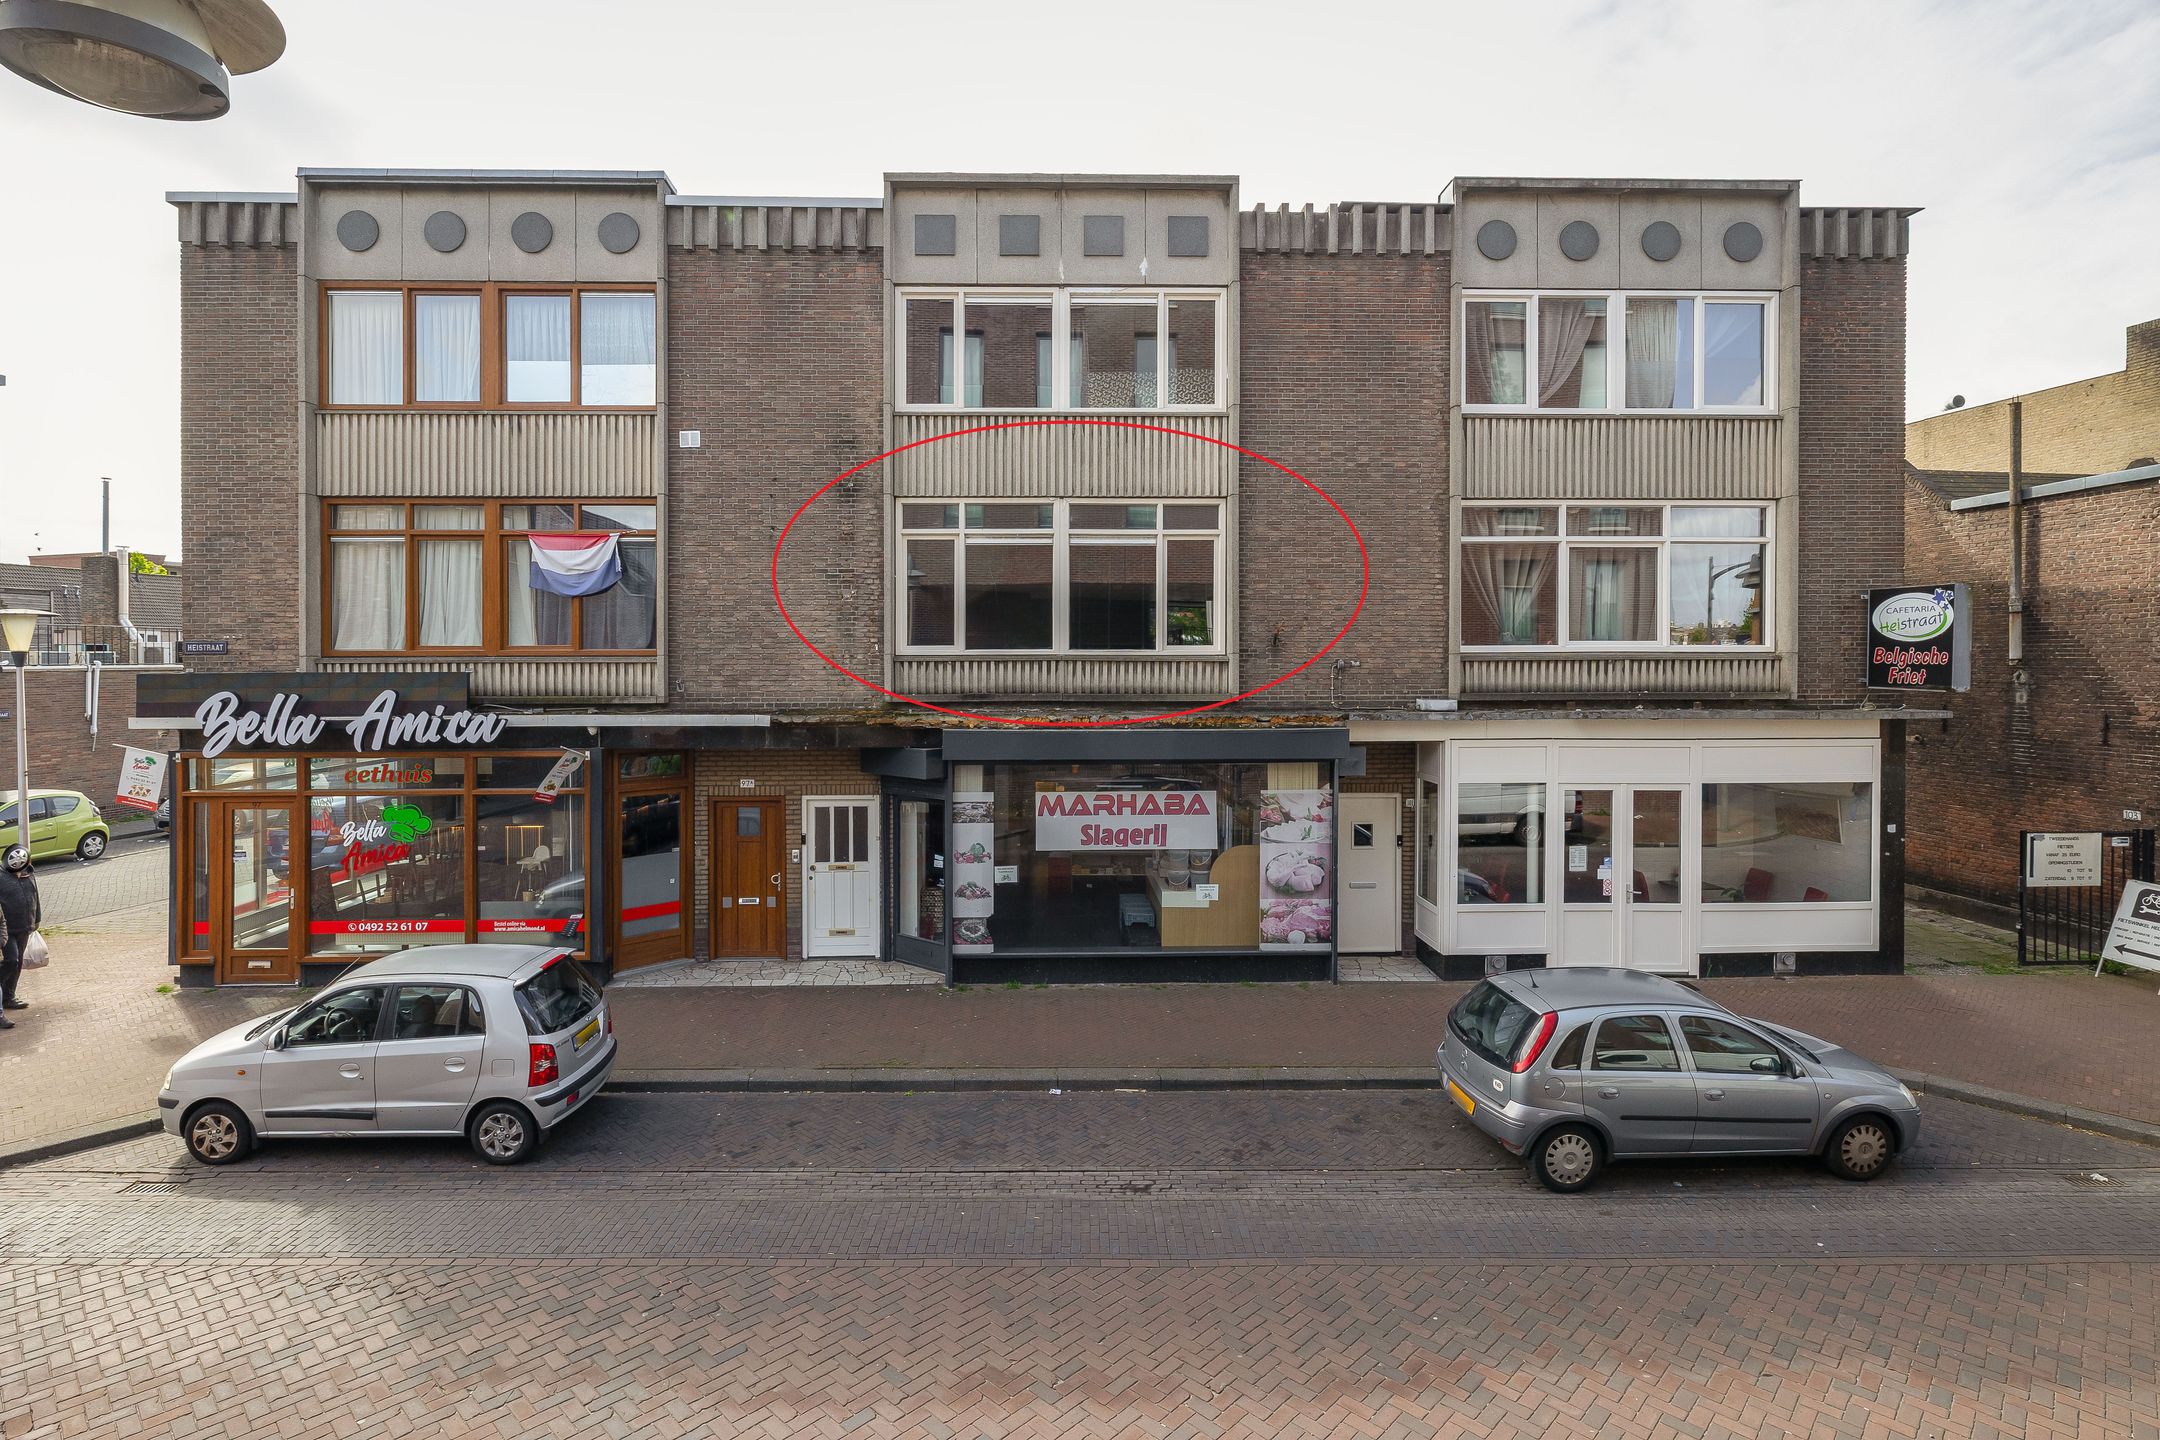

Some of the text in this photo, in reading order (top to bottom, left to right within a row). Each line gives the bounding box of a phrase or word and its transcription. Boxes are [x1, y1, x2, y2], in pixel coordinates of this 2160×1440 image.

[1886, 605, 1936, 615] CAFETARIA
[1880, 612, 1943, 633] Heistraat
[1873, 646, 1949, 668] Belgische
[1888, 666, 1927, 684] Friet
[194, 689, 507, 758] Bella Amica
[344, 763, 433, 783] eethuis
[1037, 793, 1211, 816] MARHABA
[2125, 811, 2139, 819] 103
[340, 820, 387, 847] Bella
[1080, 823, 1168, 848] Slagerij
[341, 841, 411, 873] Amica
[358, 922, 428, 932] 0492 52 61 07
[2117, 917, 2150, 929] FIETSWINKEL
